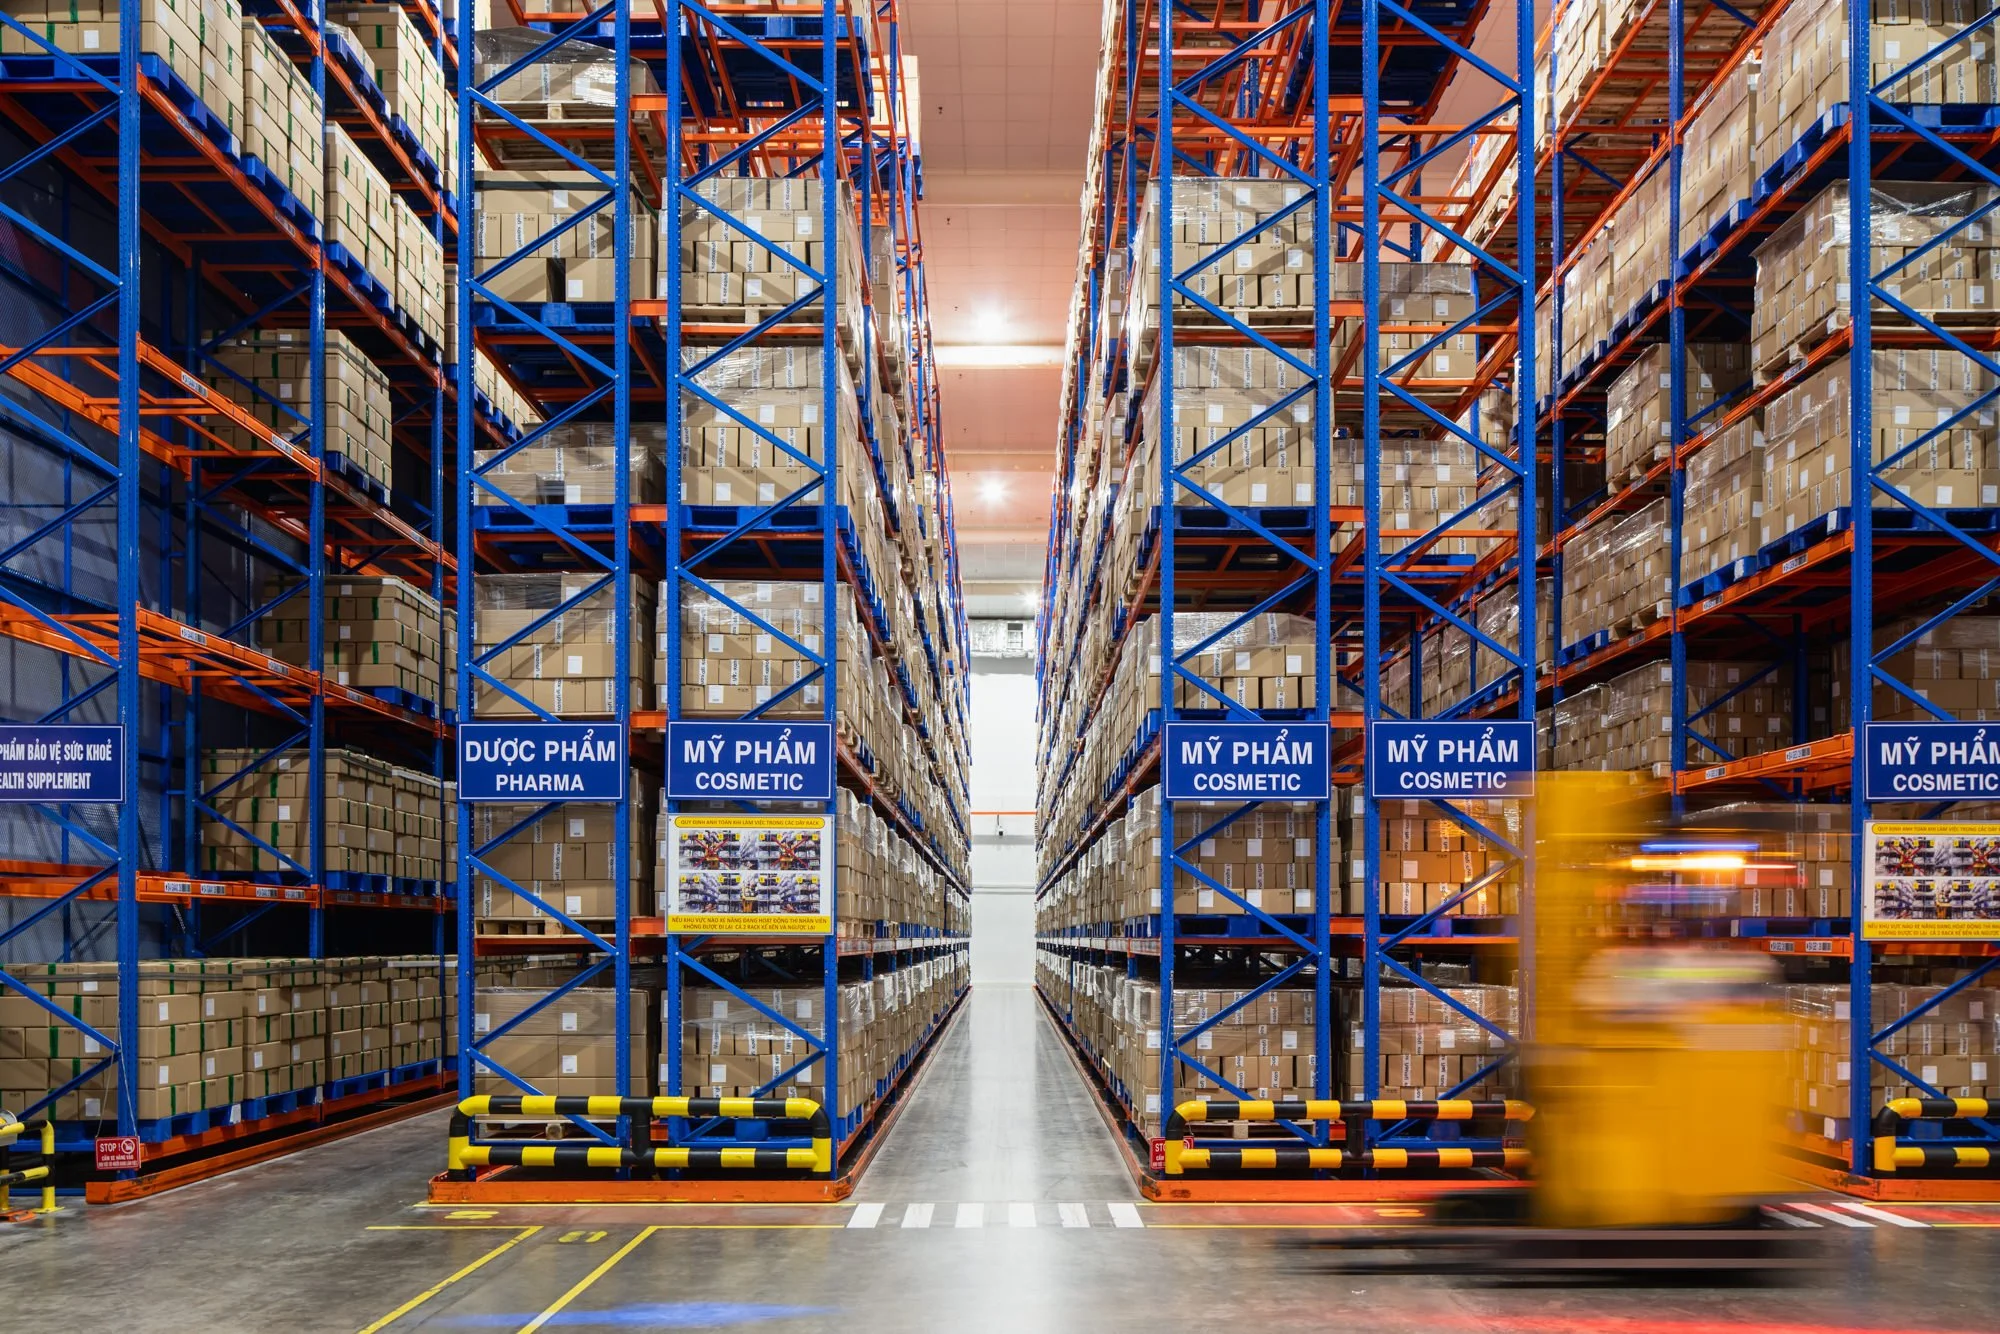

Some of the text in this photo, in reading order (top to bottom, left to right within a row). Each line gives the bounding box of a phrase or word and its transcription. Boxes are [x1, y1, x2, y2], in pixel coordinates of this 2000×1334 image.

[27, 738, 47, 761] BẢO
[49, 740, 61, 764] VỆ
[64, 740, 84, 761] SỨC
[86, 738, 112, 761] KHOẺ
[465, 728, 616, 766] DƯỢC PHẨM
[684, 728, 816, 765] MỸ PHẨM
[1181, 728, 1313, 765] MỸ PHẨM
[1388, 726, 1519, 763] MỸ PHẨM
[1881, 735, 1921, 765] MỸ
[27, 772, 91, 789] SUPPLEMENT
[496, 774, 584, 791] PHARMA
[695, 772, 804, 791] COSMETIC
[1193, 773, 1301, 791] COSMETIC
[1400, 771, 1507, 789] COSMETIC
[1892, 773, 1999, 791] COSMETIC
[100, 1143, 117, 1152] STOP
